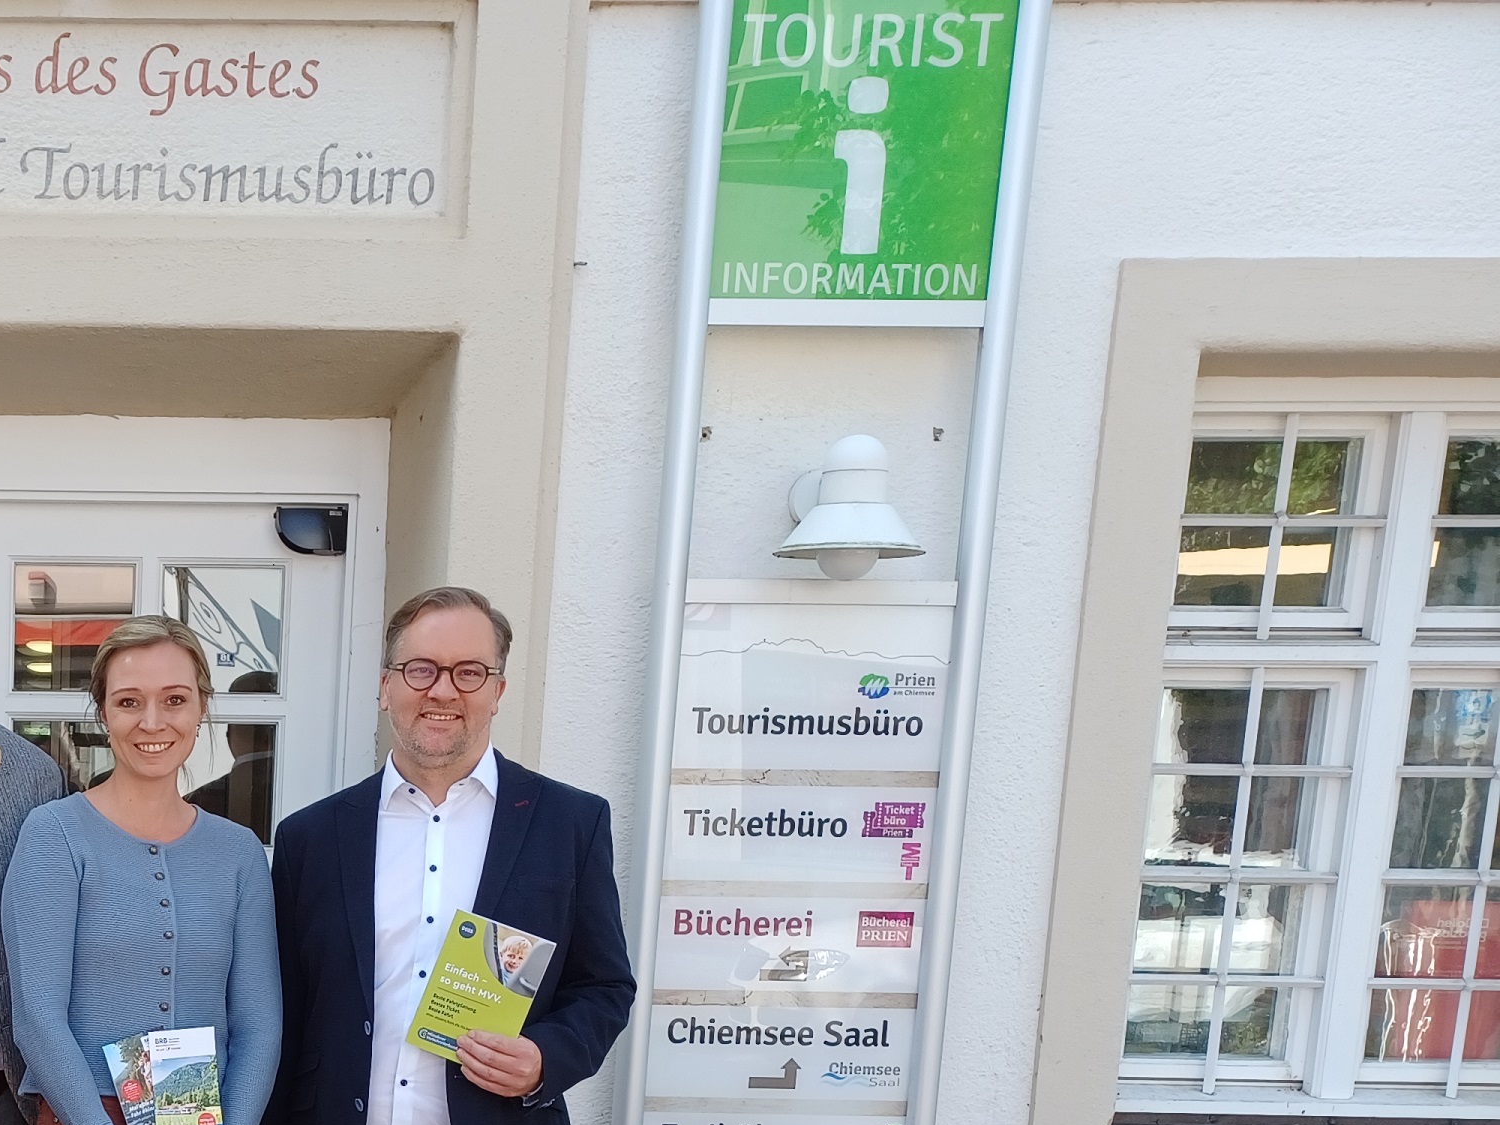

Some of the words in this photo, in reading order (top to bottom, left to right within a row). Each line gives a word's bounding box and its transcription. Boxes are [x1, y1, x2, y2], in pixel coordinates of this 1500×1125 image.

[743, 13, 1004, 69] TOURIST
[34, 31, 118, 98] des
[137, 42, 320, 116] Gastes
[19, 142, 436, 208] Tourismusbüro
[721, 261, 978, 297] INFORMATION
[895, 673, 935, 686] Prien
[692, 706, 924, 736] Tourismusbüro
[884, 804, 915, 815] Ticket
[884, 815, 907, 825] büro
[683, 808, 848, 838] Ticketbüro
[882, 829, 903, 837] Prien
[673, 908, 814, 938] Bücherei
[861, 916, 911, 929] Bücherei
[860, 929, 910, 942] PRIEN
[444, 962, 480, 983] Einfach
[439, 975, 451, 985] so
[453, 981, 477, 995] geht
[478, 988, 502, 1004] MVV.
[667, 1018, 814, 1046] Chiemsee
[823, 1020, 890, 1048] Saal
[829, 1062, 901, 1076] Chiemsee
[869, 1077, 901, 1087] Saal
